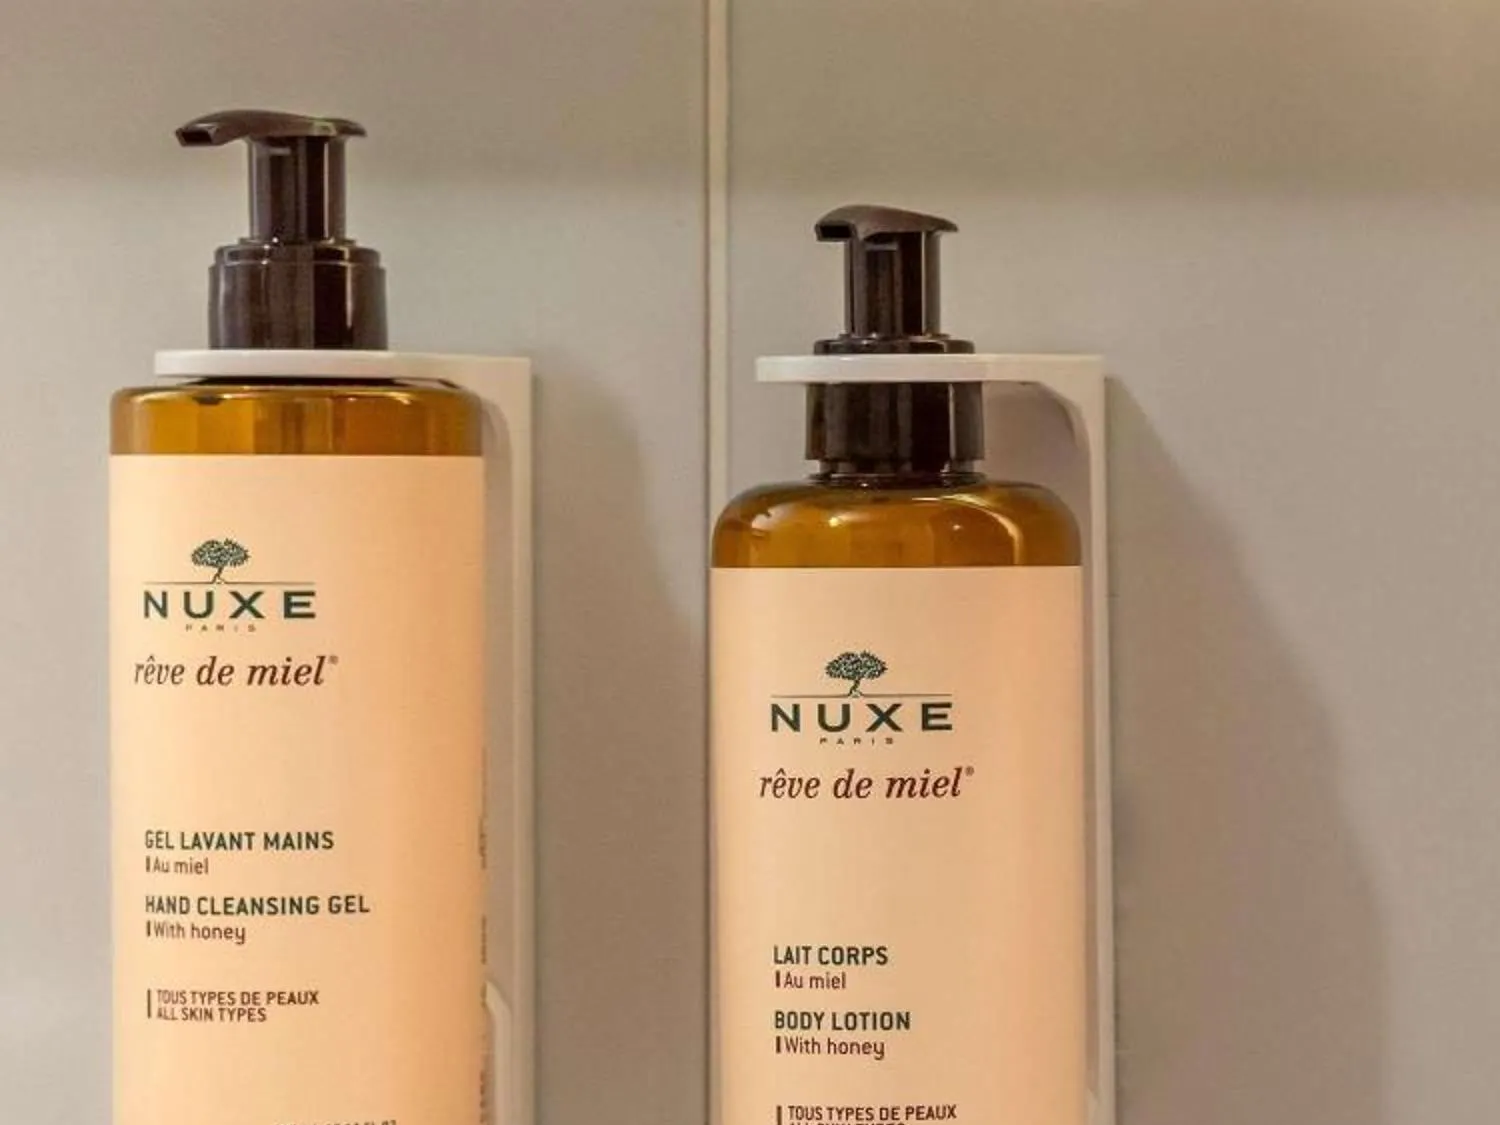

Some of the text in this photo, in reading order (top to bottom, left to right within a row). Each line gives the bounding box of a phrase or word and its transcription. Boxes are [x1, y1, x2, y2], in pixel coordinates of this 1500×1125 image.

[144, 591, 316, 619] NUXE
[186, 624, 256, 632] PARIS
[134, 654, 185, 685] rêve
[196, 655, 234, 686] de
[771, 702, 953, 732] NUXE
[759, 768, 820, 799] rêve
[833, 768, 872, 799] de
[145, 830, 334, 851] GEL LAVANT MAINS
[153, 857, 209, 874] Au miel
[145, 895, 370, 916] HAND CLEANSING GEL
[153, 921, 246, 944] With honey
[773, 945, 888, 966] LAIT CORPS
[784, 972, 846, 989] Au miel
[157, 990, 319, 1005] TOUS TYPES DE PEAUX
[157, 1007, 267, 1022] ALL SKIN TYPES
[775, 1011, 910, 1030] BODY LOTION
[784, 1037, 884, 1060] With honey
[789, 1104, 957, 1121] TOUS TYPES DE PEAUX
